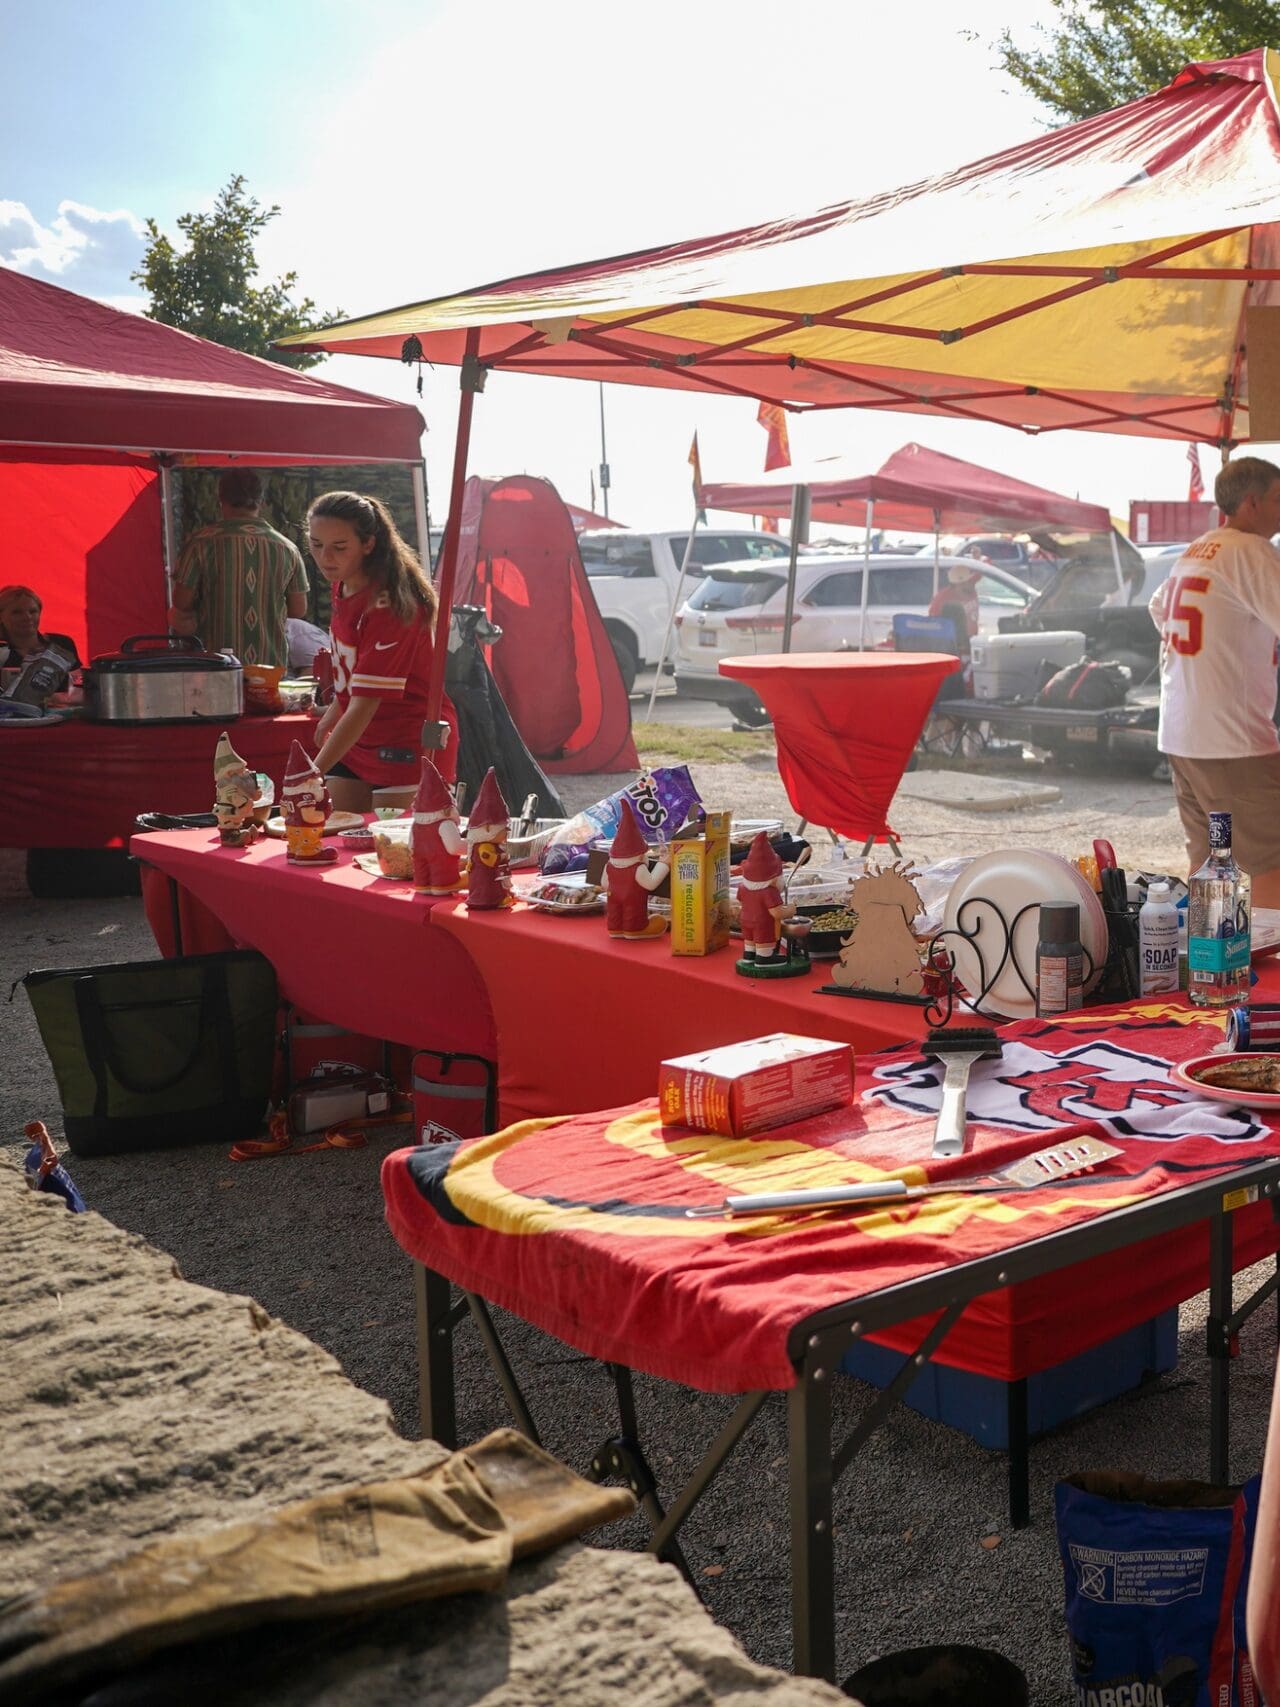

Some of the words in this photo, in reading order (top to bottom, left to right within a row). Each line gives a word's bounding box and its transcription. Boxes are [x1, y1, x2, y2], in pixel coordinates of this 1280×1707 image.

[686, 884, 695, 925] reduced
[686, 926, 696, 943] fat
[1145, 948, 1177, 964] SOAP
[1077, 1548, 1114, 1564] WARNING
[1117, 1553, 1144, 1563] CARBON
[1145, 1552, 1180, 1561] MONOXIDE
[1181, 1550, 1207, 1561] HAZARD
[1117, 1588, 1137, 1596] NEVER
